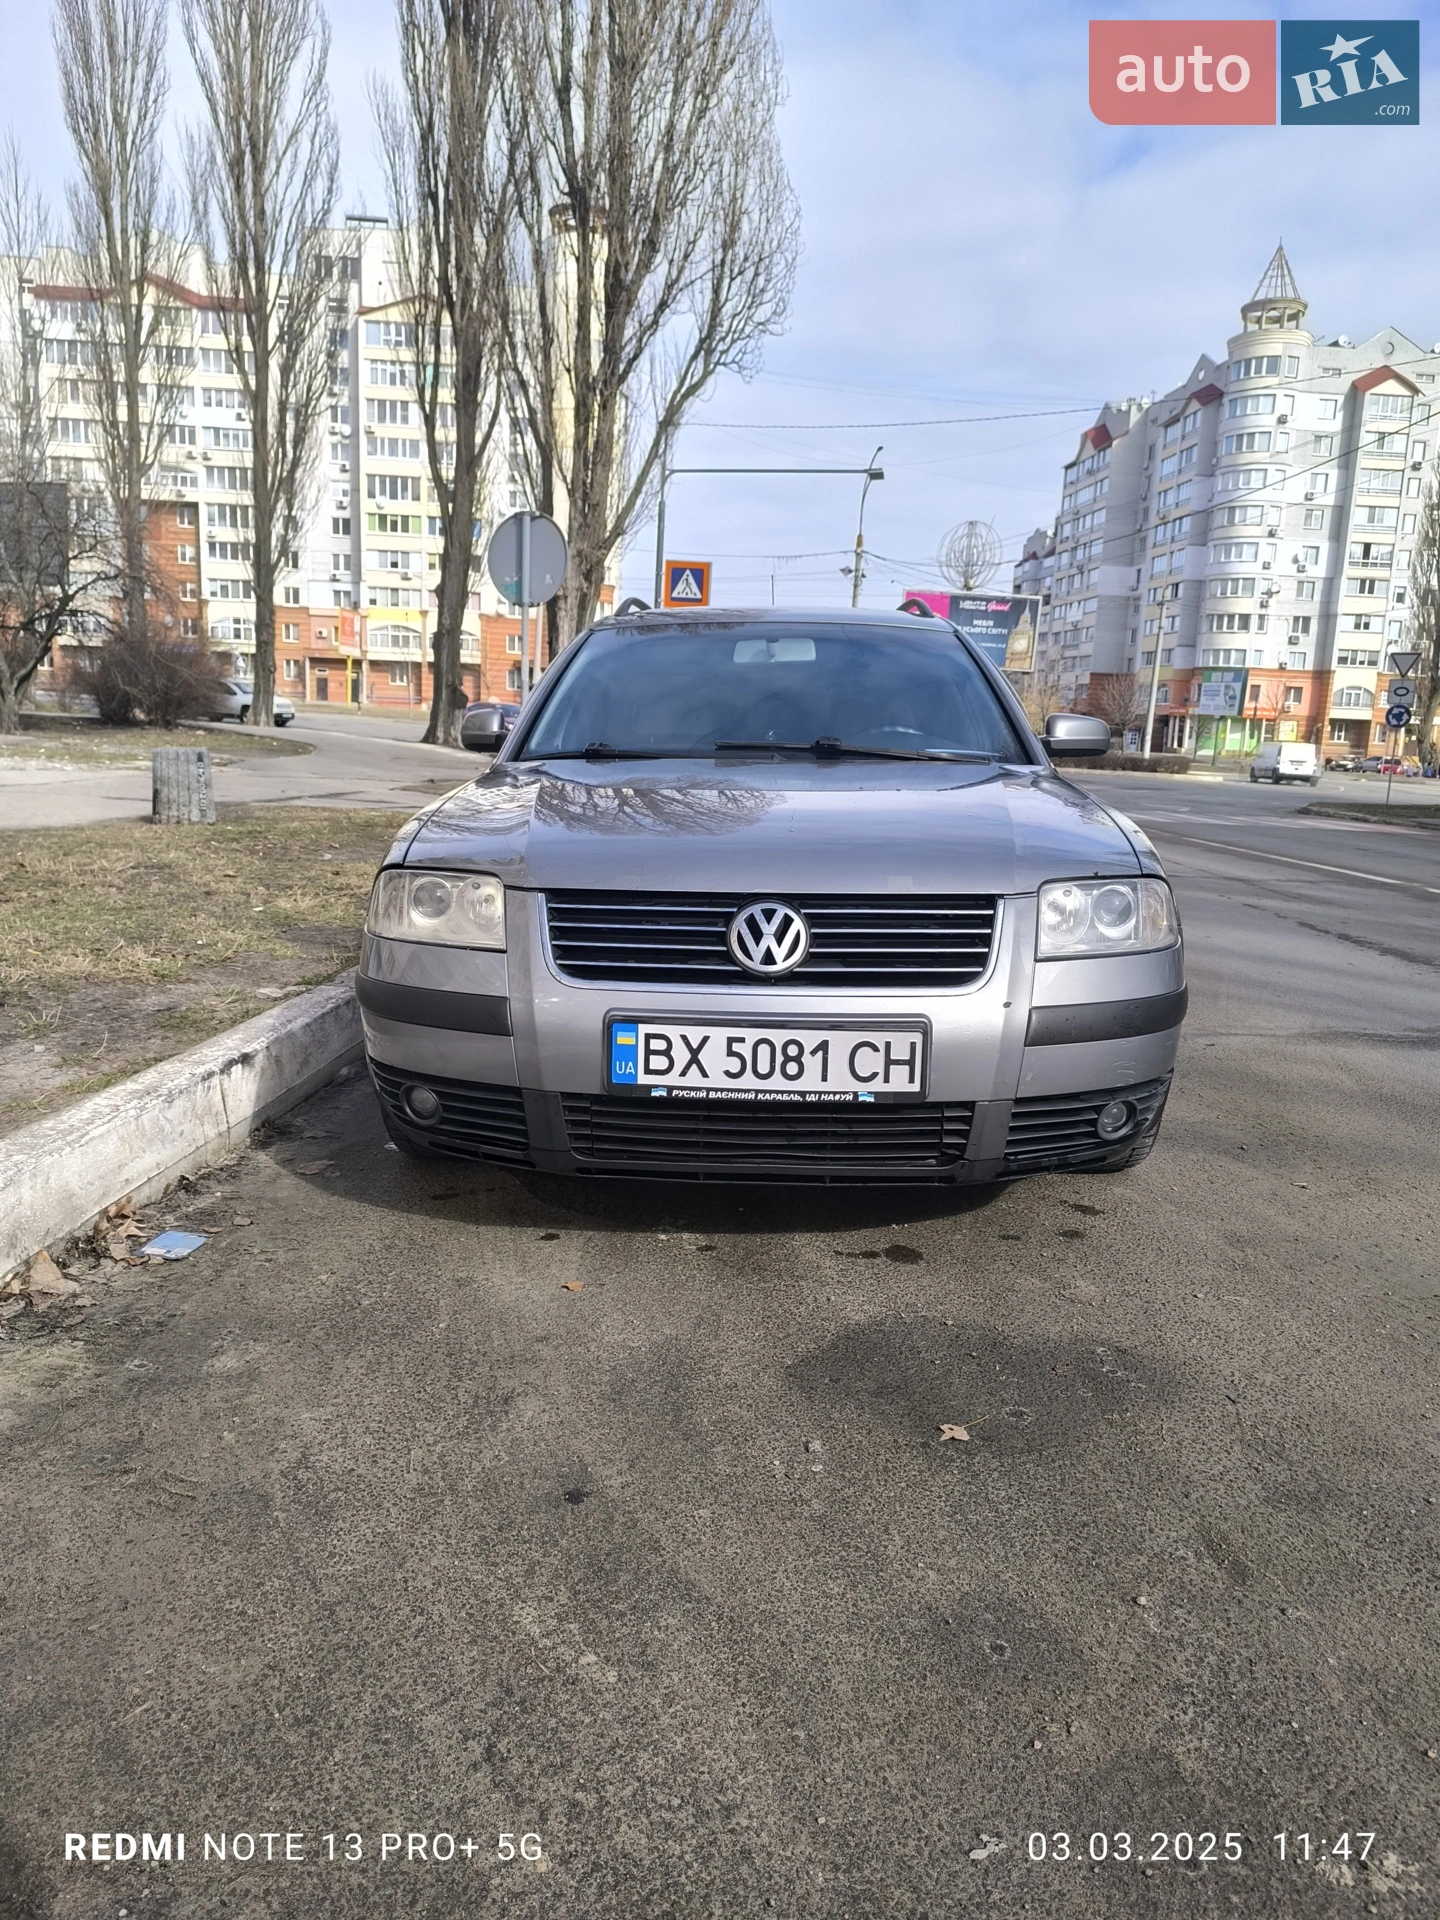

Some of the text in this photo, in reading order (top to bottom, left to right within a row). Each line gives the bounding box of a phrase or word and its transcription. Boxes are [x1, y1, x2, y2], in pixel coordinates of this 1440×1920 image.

[643, 1033, 917, 1084] BX 5081 CH
[615, 1060, 635, 1075] UA
[672, 1089, 707, 1098] РУСКІЙ
[708, 1090, 755, 1100] ВАЄННИЙ
[757, 1092, 803, 1102] КАРАБЛЬ,
[805, 1093, 819, 1102] ІДІ
